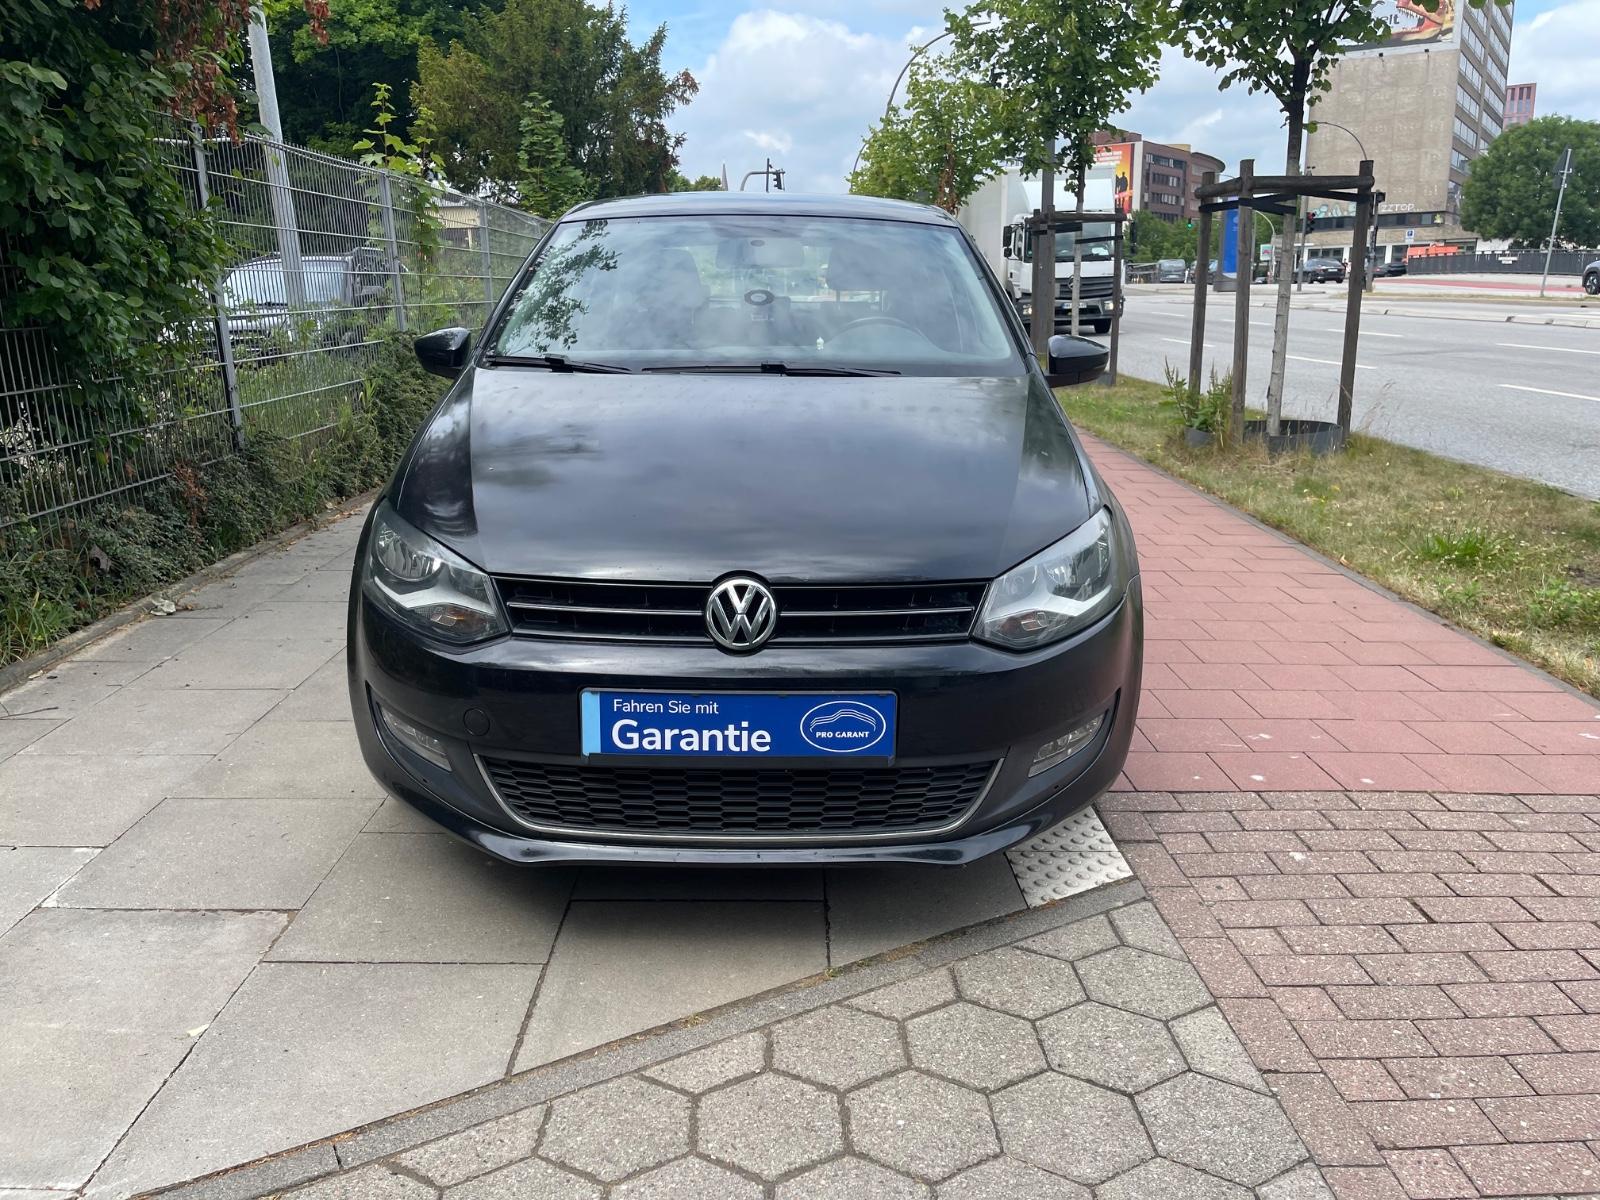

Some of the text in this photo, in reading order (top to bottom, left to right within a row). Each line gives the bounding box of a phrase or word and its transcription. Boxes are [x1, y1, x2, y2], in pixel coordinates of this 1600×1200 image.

[613, 699, 719, 714] Fahren Sie mit
[611, 718, 772, 752] Garantie
